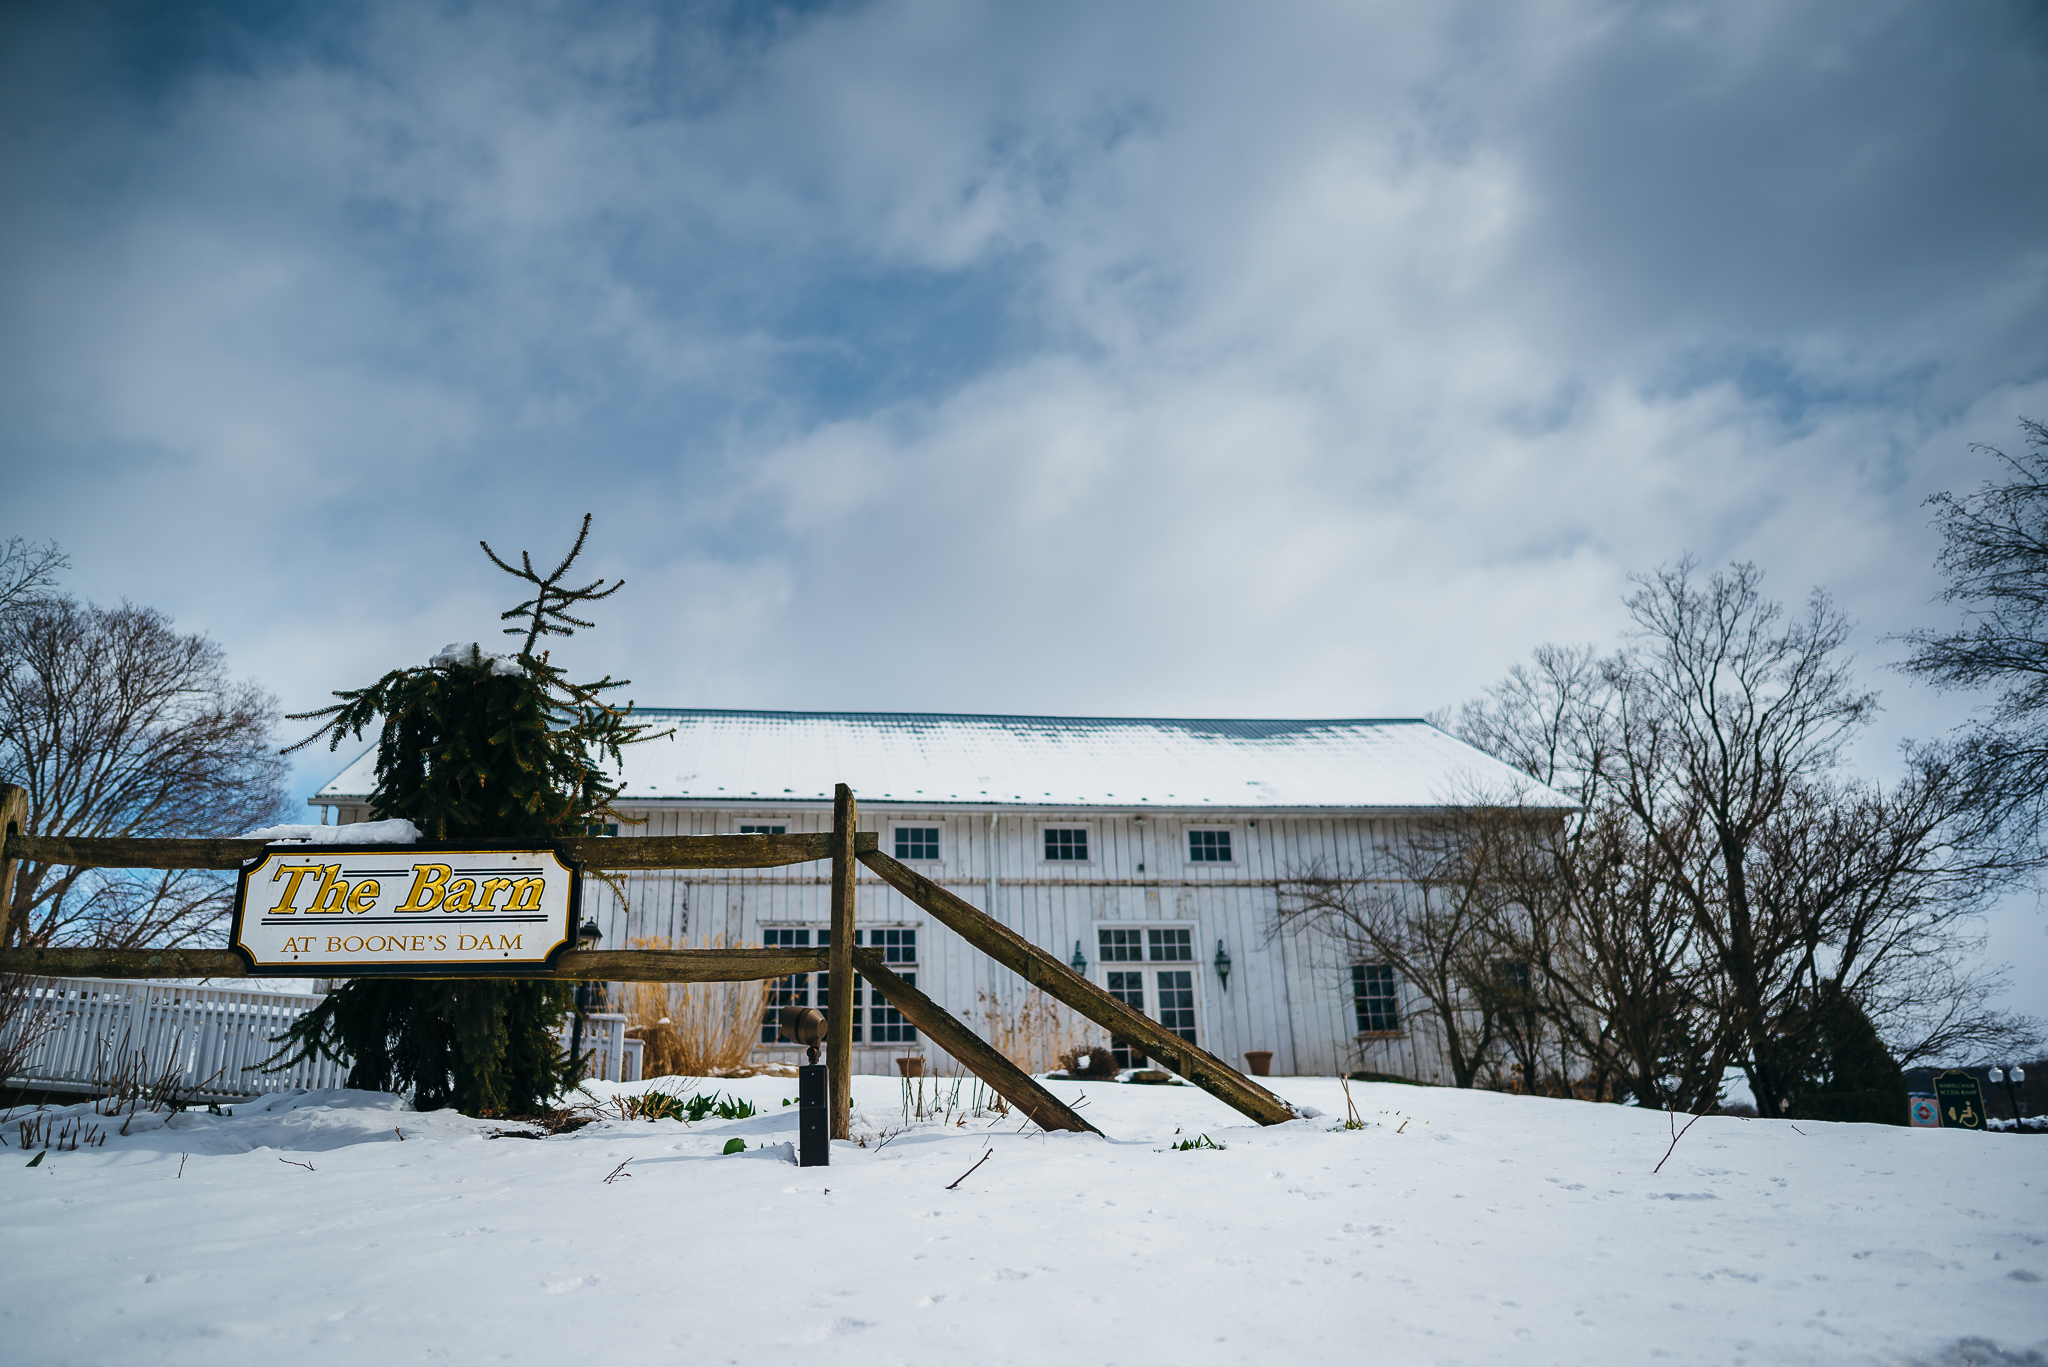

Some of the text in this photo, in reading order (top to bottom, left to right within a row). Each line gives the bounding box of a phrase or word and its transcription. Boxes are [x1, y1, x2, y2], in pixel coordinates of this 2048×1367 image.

[268, 863, 546, 915] The Barn
[280, 934, 524, 953] AT BOONE'S DAM
